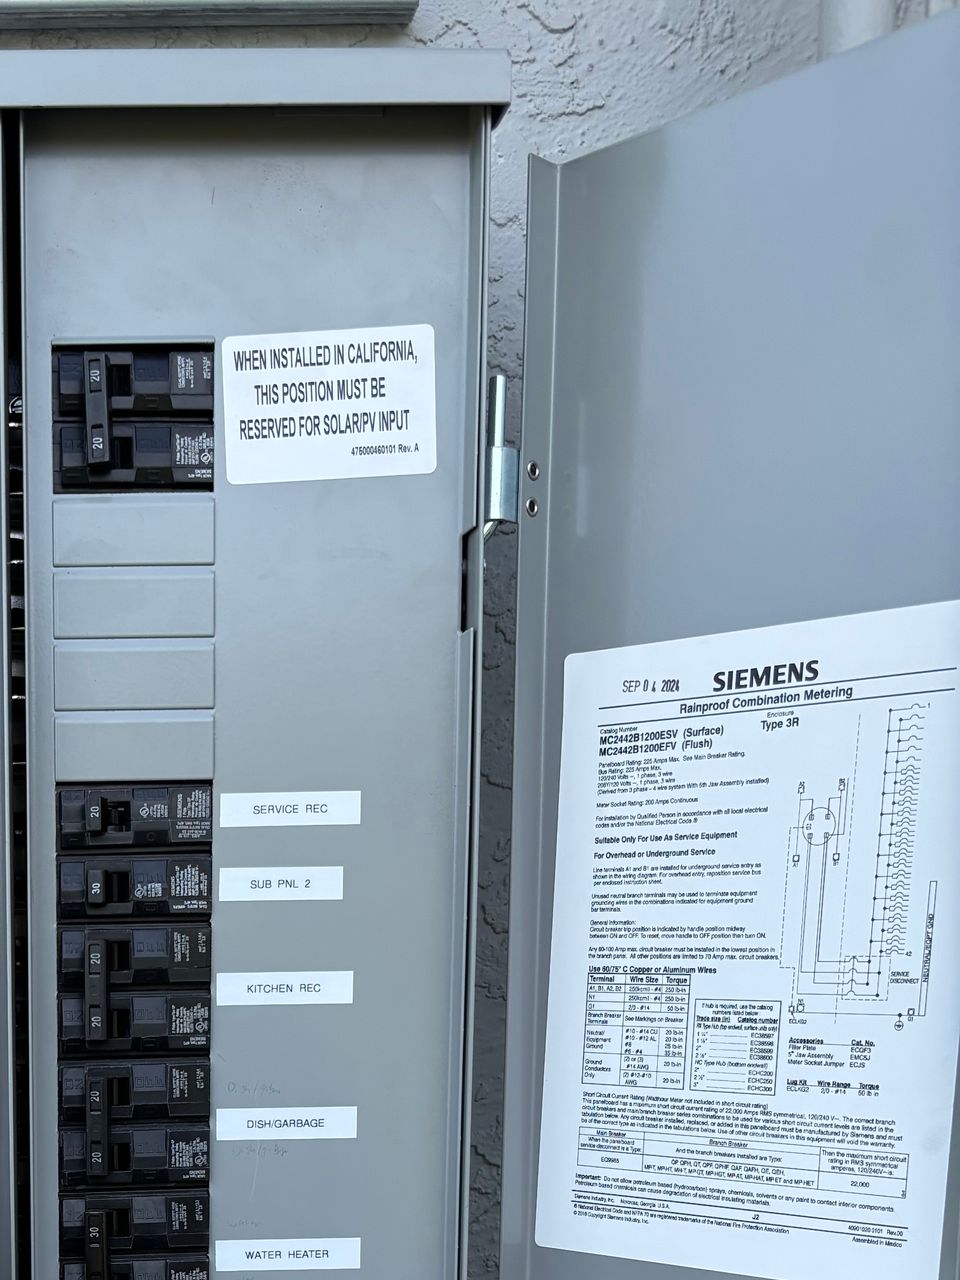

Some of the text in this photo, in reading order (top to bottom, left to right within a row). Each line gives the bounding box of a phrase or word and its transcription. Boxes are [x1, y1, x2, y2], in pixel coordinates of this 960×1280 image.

[234, 350, 266, 372] WHEN
[270, 345, 330, 369] INSTALLED
[333, 344, 344, 366] IN
[347, 340, 418, 365] CALIFORNIA,
[91, 369, 100, 383] 20
[254, 377, 386, 406] THIS POSITION MUST BE
[239, 410, 410, 440] RESERVED FOR SOLAR/PV INPUT
[93, 436, 102, 450] 20
[398, 445, 412, 454] Rev.
[414, 444, 419, 452] A
[713, 660, 818, 692] SIEMENS
[623, 680, 640, 692] SEP
[661, 679, 680, 692] 2024
[680, 686, 853, 714] Rainproof Combination Metering
[767, 710, 794, 718] Enclosure
[761, 717, 799, 732] Type 3R
[683, 725, 723, 739] (Surface)
[682, 739, 712, 751] (Flush)
[91, 806, 99, 818] 20
[252, 804, 328, 815] SERVICE REC
[595, 836, 620, 844] Suitable
[622, 835, 636, 844] Only
[701, 831, 737, 841] Equipment
[646, 849, 689, 858] Underground
[690, 848, 715, 856] Service
[92, 883, 100, 894] 30
[250, 879, 311, 889] SUB PNL 2
[91, 953, 100, 964] 20
[630, 966, 653, 974] Copper
[247, 984, 321, 994] KITCHEN REC
[92, 1016, 101, 1027] 20
[91, 1091, 99, 1102] 20
[246, 1119, 325, 1129] DISH/GARBAGE
[93, 1152, 101, 1163] 20
[90, 1227, 99, 1238] 30
[245, 1250, 329, 1260] WATER HEATER
